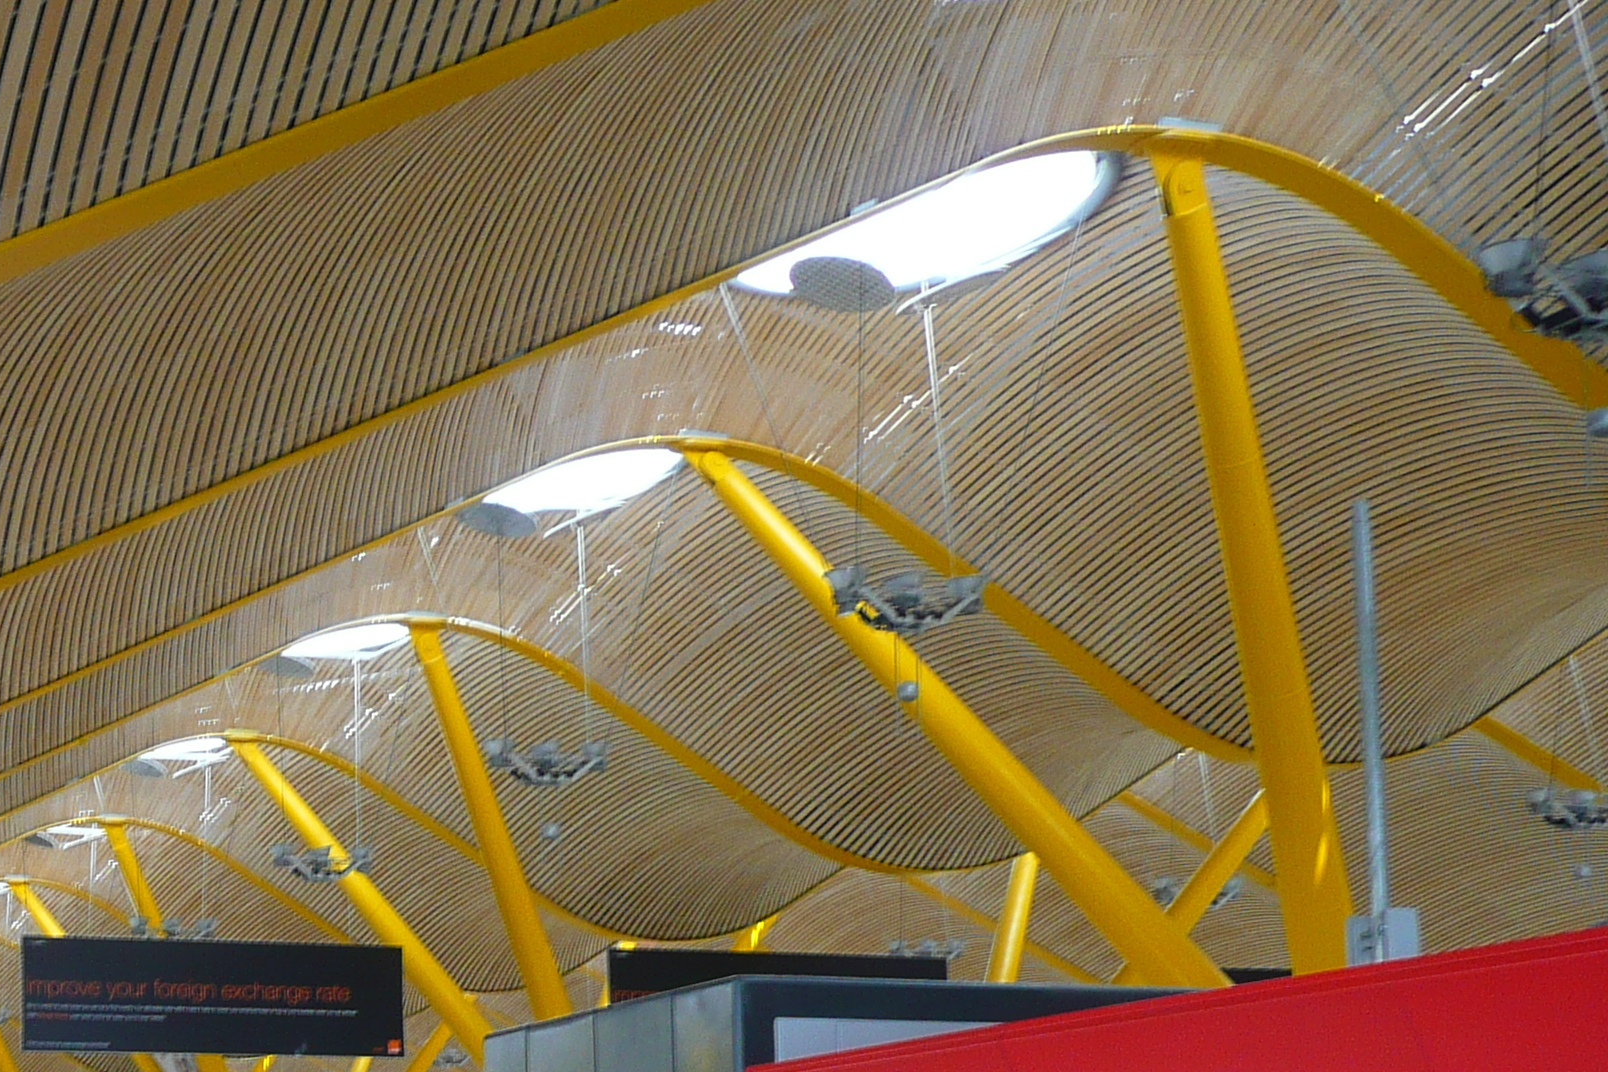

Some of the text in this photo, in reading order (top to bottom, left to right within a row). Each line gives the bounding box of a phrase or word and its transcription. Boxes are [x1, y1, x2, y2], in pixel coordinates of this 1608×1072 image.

[107, 981, 148, 1001] your
[154, 978, 216, 1003] foreign
[221, 981, 312, 1006] exchange
[316, 985, 352, 1003] rate
